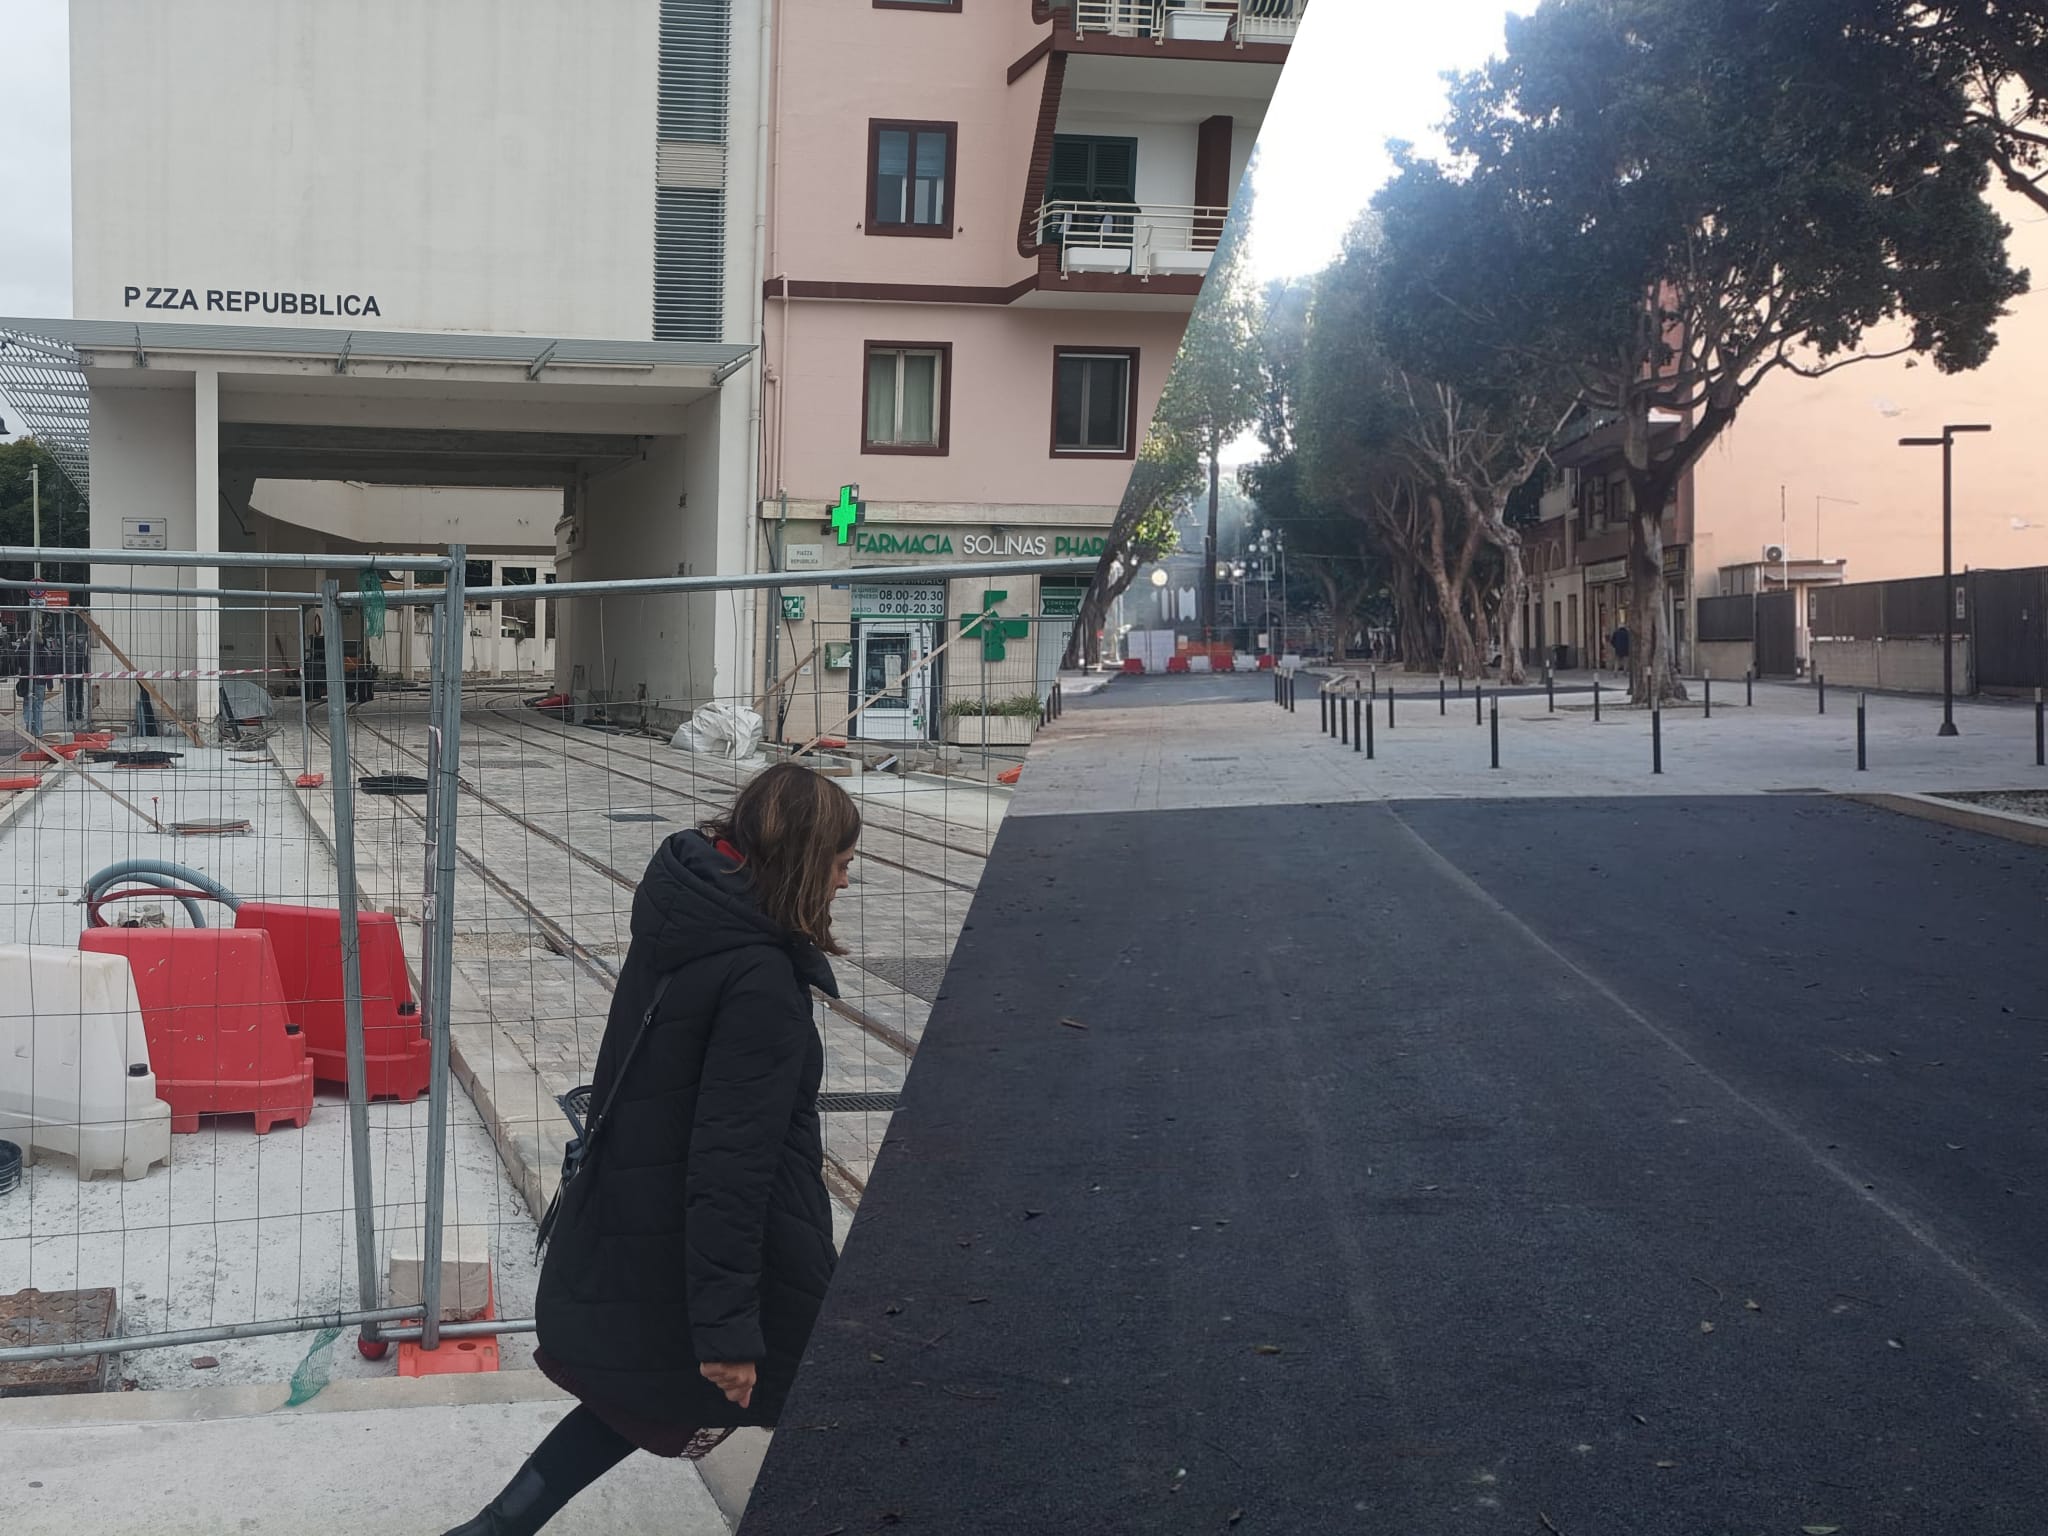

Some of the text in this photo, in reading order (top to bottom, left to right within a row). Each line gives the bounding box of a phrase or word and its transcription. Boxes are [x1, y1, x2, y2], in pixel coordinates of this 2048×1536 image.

[206, 289, 381, 317] REPUBBLICA
[856, 533, 953, 554] FARMACIA
[963, 534, 1046, 556] SOLINAS
[879, 590, 943, 601] 08.00-20.30
[879, 603, 943, 614] 09.00-20.30
